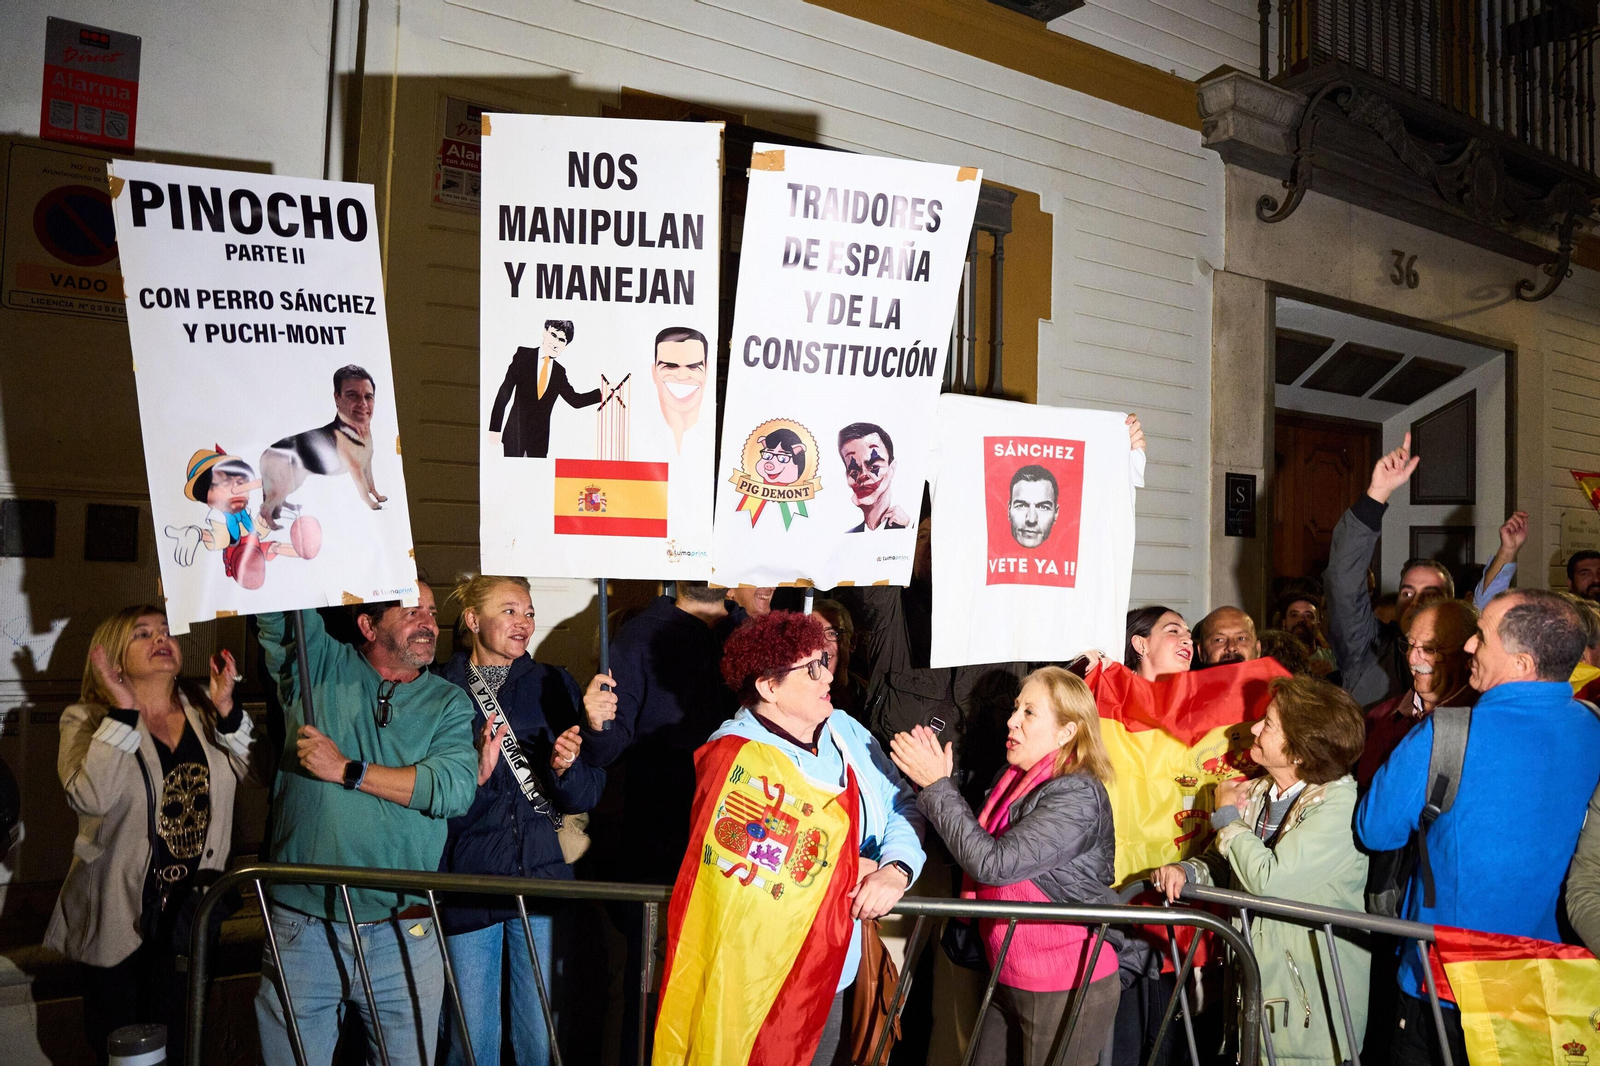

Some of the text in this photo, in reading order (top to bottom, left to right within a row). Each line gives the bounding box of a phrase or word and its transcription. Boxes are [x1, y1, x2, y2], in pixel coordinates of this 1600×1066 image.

[63, 46, 124, 64] Direct
[51, 72, 130, 100] Alarma
[446, 157, 458, 165] con
[460, 160, 478, 170] Aviso
[569, 151, 637, 190] NOS
[129, 180, 367, 242] PINOCHO
[787, 182, 942, 233] TRAIDORES
[499, 205, 703, 249] MANIPULAN
[225, 244, 304, 264] PARTE II
[782, 236, 930, 282] DE ESPAÑA
[1390, 249, 1419, 289] 36
[50, 273, 108, 292] VADO
[504, 262, 694, 305] Y MANEJAN
[31, 297, 74, 309] LICENCIA
[140, 288, 376, 315] CON PERRO SÁNCHEZ
[804, 290, 900, 330] Y DE LA
[183, 324, 346, 344] Y PUCHI-MONT
[743, 335, 937, 378] CONSTITUCIÓN
[994, 440, 1074, 460] SÁNCHEZ
[739, 481, 809, 499] PIG DEMONT
[1236, 486, 1245, 503] S
[989, 558, 1076, 577] VETE YA !!
[492, 718, 504, 729] Y
